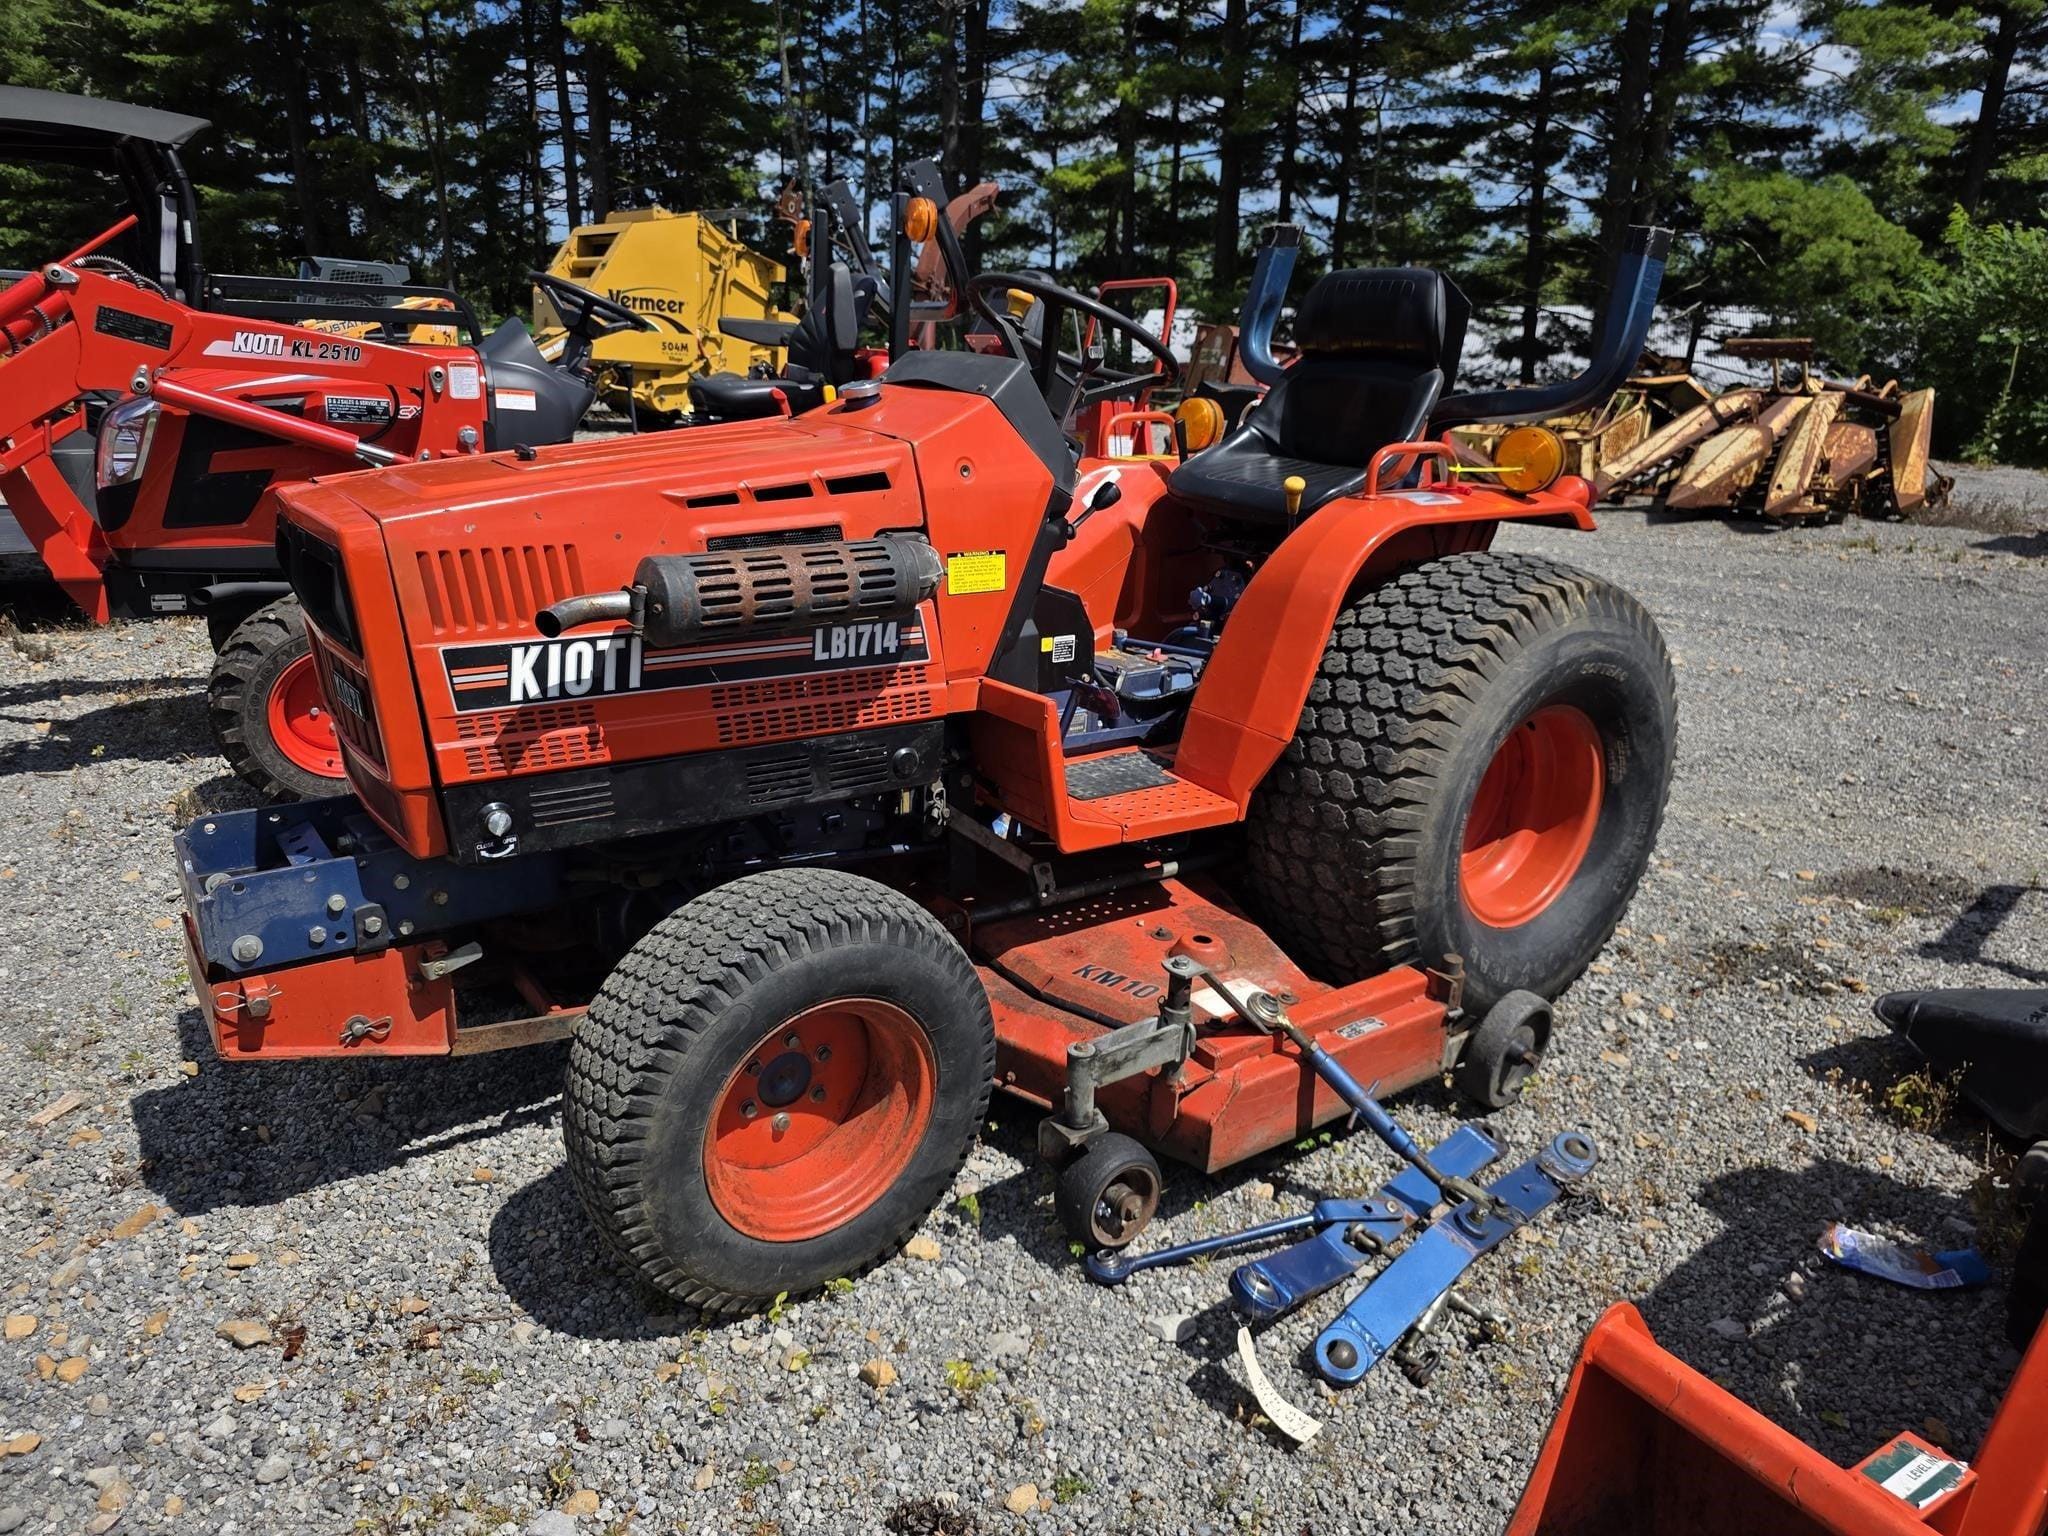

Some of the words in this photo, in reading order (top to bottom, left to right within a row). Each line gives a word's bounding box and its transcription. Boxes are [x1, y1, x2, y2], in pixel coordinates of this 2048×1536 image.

[608, 288, 685, 314] Vermeer
[232, 331, 285, 356] KIOTI
[291, 339, 314, 358] KL
[319, 343, 361, 362] 2510
[661, 341, 689, 352] 504M
[814, 621, 899, 661] LB1714
[510, 638, 642, 702] KIOTI
[476, 841, 495, 850] CLOSE
[1906, 1463, 1932, 1481] LEVEL
